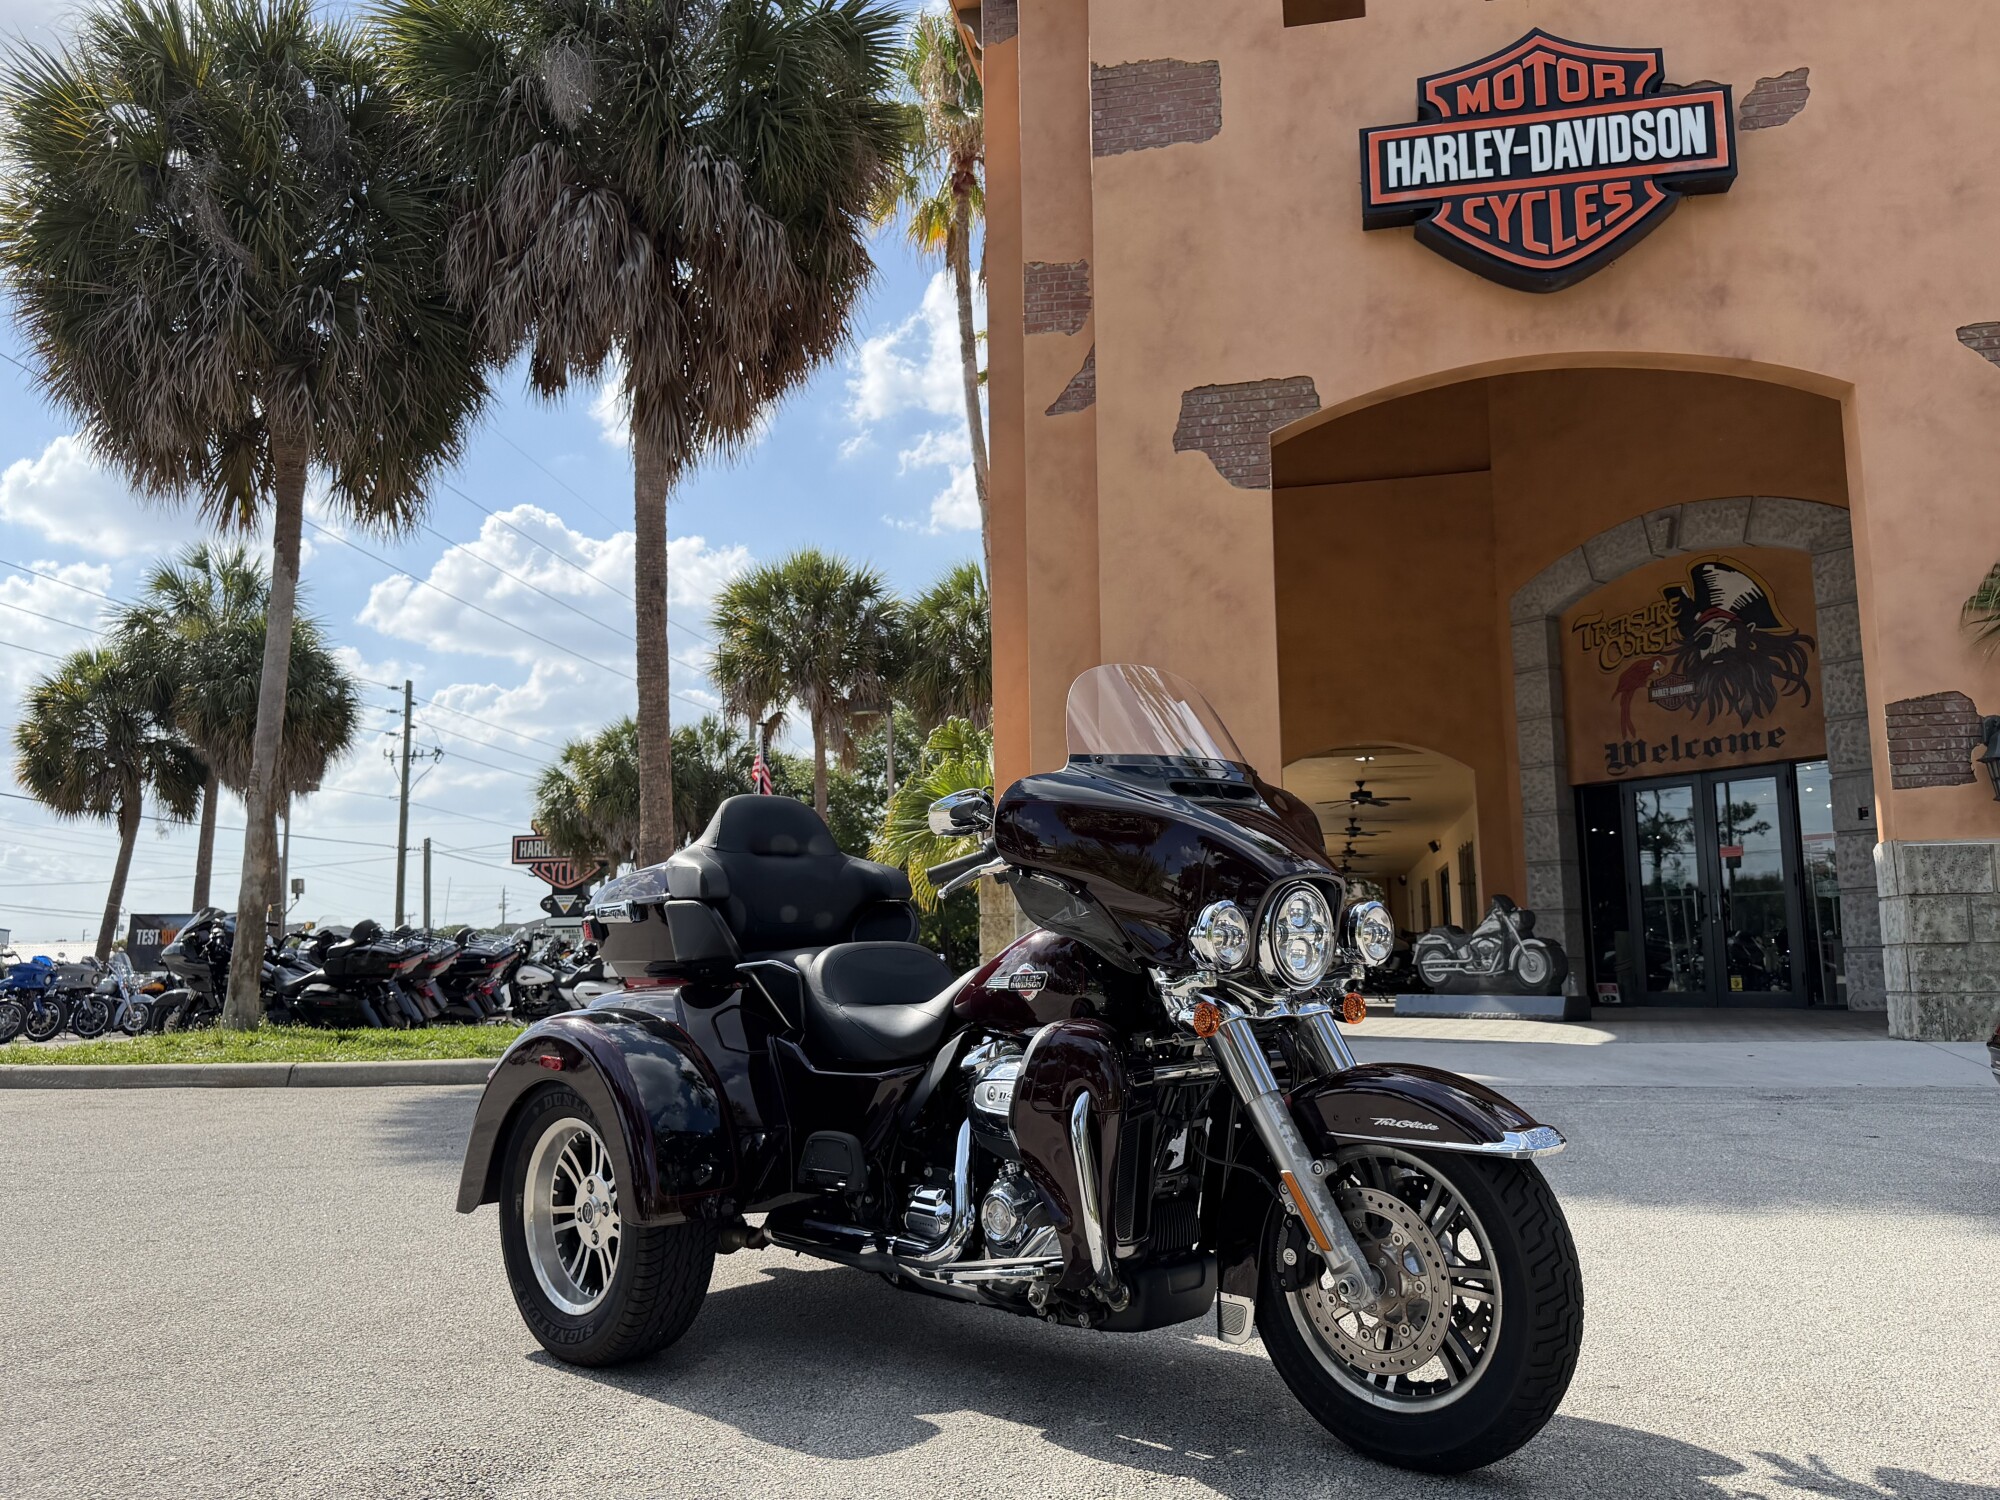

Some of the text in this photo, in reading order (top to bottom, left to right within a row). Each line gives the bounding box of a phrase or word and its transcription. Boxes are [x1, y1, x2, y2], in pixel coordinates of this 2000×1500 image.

[1456, 50, 1626, 115] MOTOR
[1386, 105, 1708, 188] HARLEY-DAVIDSON
[1462, 180, 1633, 255] CYCLES
[1605, 726, 1786, 775] Welcome
[136, 928, 161, 946] TEST
[1010, 981, 1042, 989] DAVIDSON
